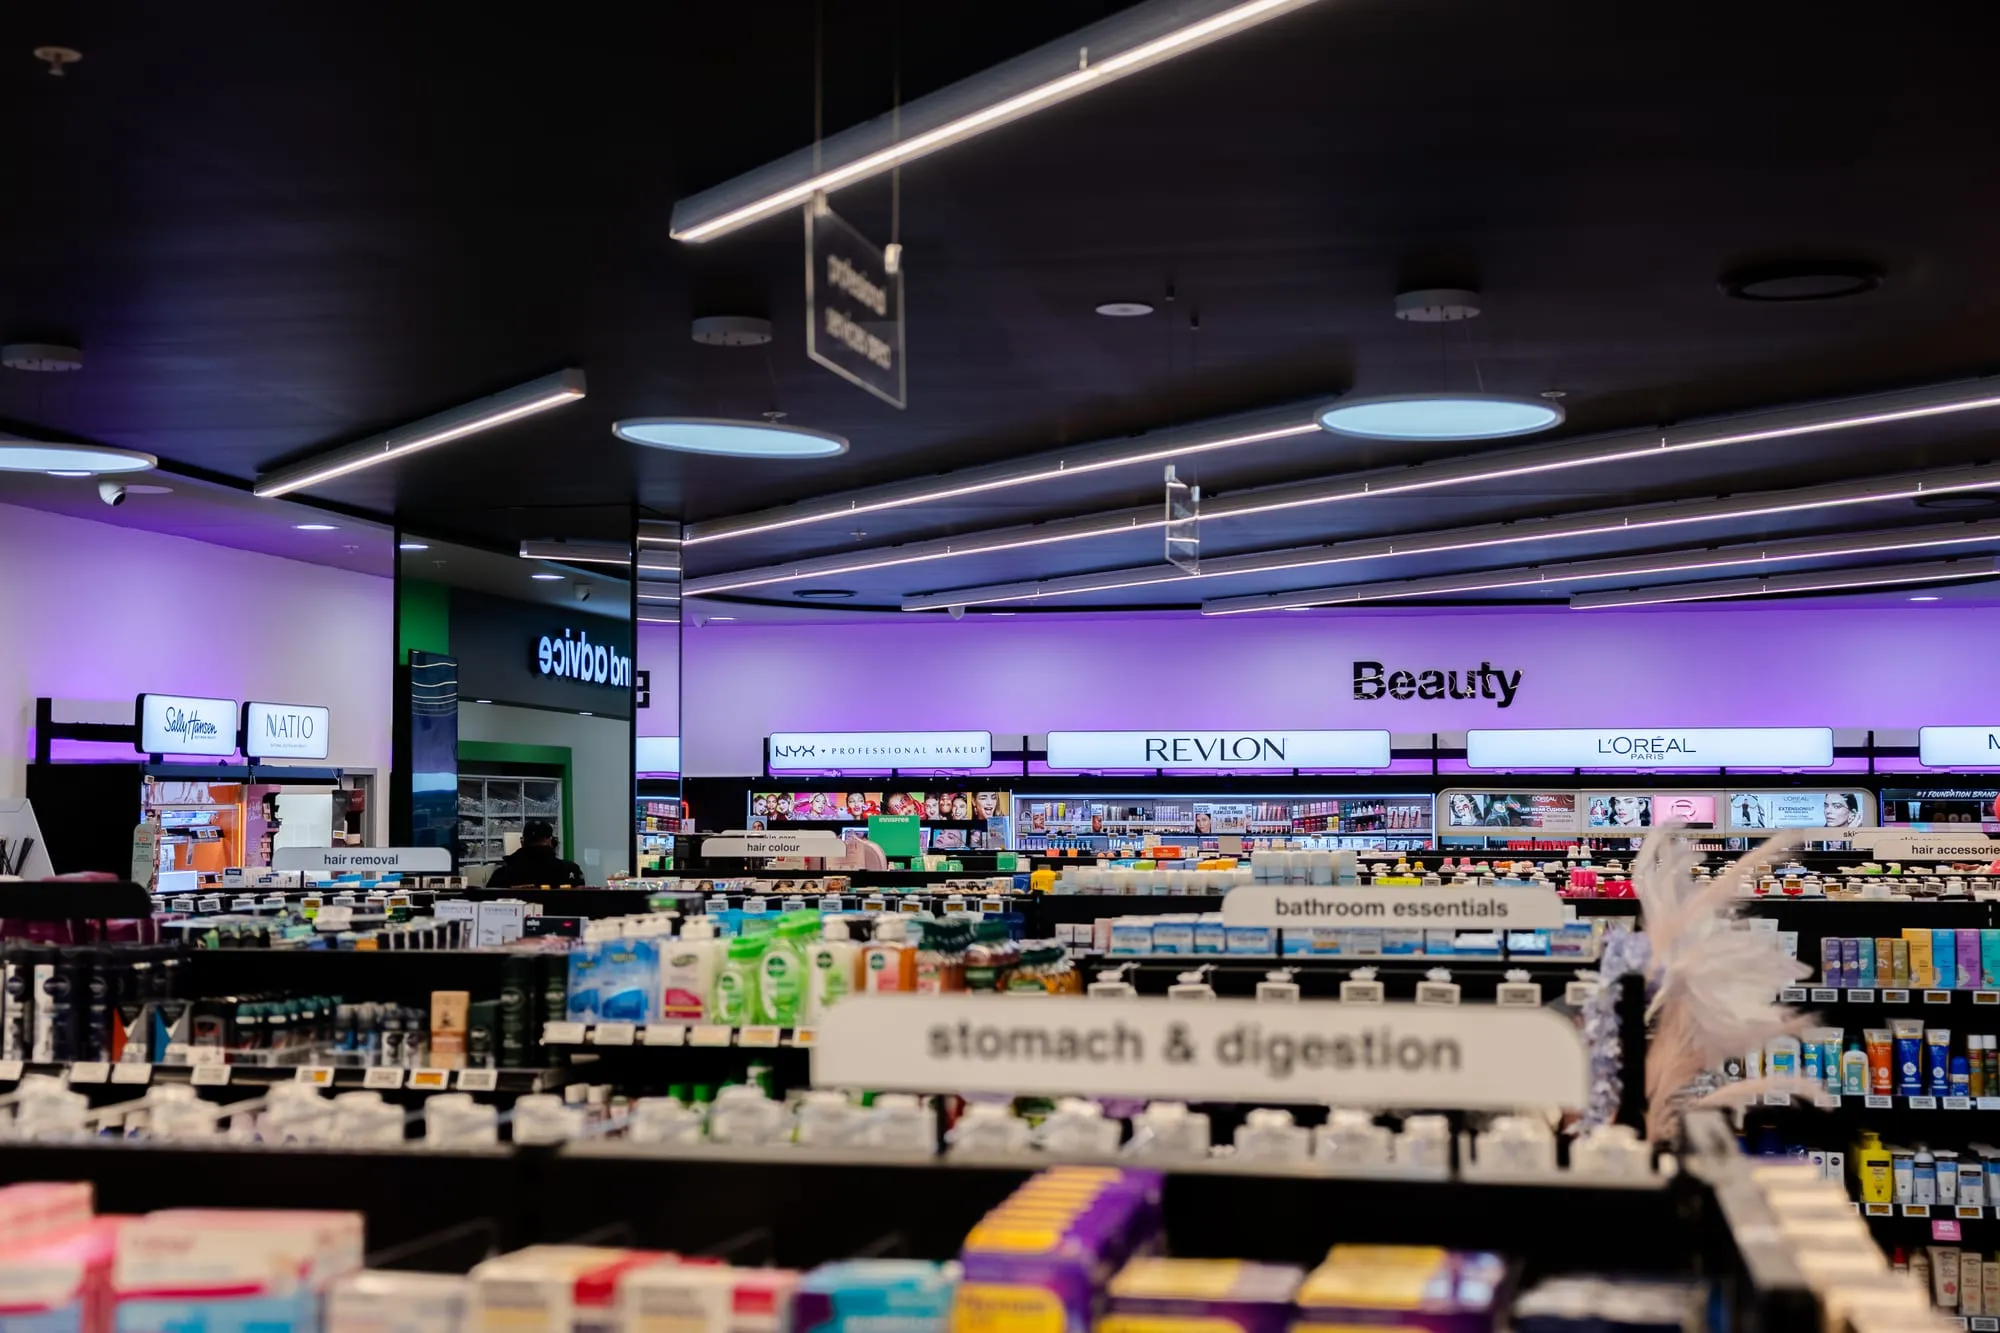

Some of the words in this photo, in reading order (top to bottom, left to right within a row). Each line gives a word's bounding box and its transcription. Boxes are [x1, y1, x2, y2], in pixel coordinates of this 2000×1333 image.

[1353, 661, 1523, 708] Beauty
[164, 706, 188, 743] Sally
[187, 710, 217, 741] Hansen
[266, 713, 314, 739] NATIO
[776, 745, 815, 757] NYX
[831, 746, 928, 755] PROFESSIONAL
[935, 746, 986, 754] MAKEUP
[1146, 737, 1285, 761] REVLON
[1598, 736, 1697, 754] L'ORÉAL
[1927, 789, 1972, 798] FOUNDATION
[747, 843, 766, 851] hair
[768, 843, 801, 852] colour
[1911, 845, 1934, 854] hair
[324, 854, 347, 864] hair
[350, 854, 399, 864] removal
[1275, 897, 1386, 918] bathroom
[1392, 897, 1509, 918] essentials
[926, 1019, 1146, 1061] stomach
[1161, 1020, 1197, 1065] &
[1214, 1020, 1463, 1078] digestion
